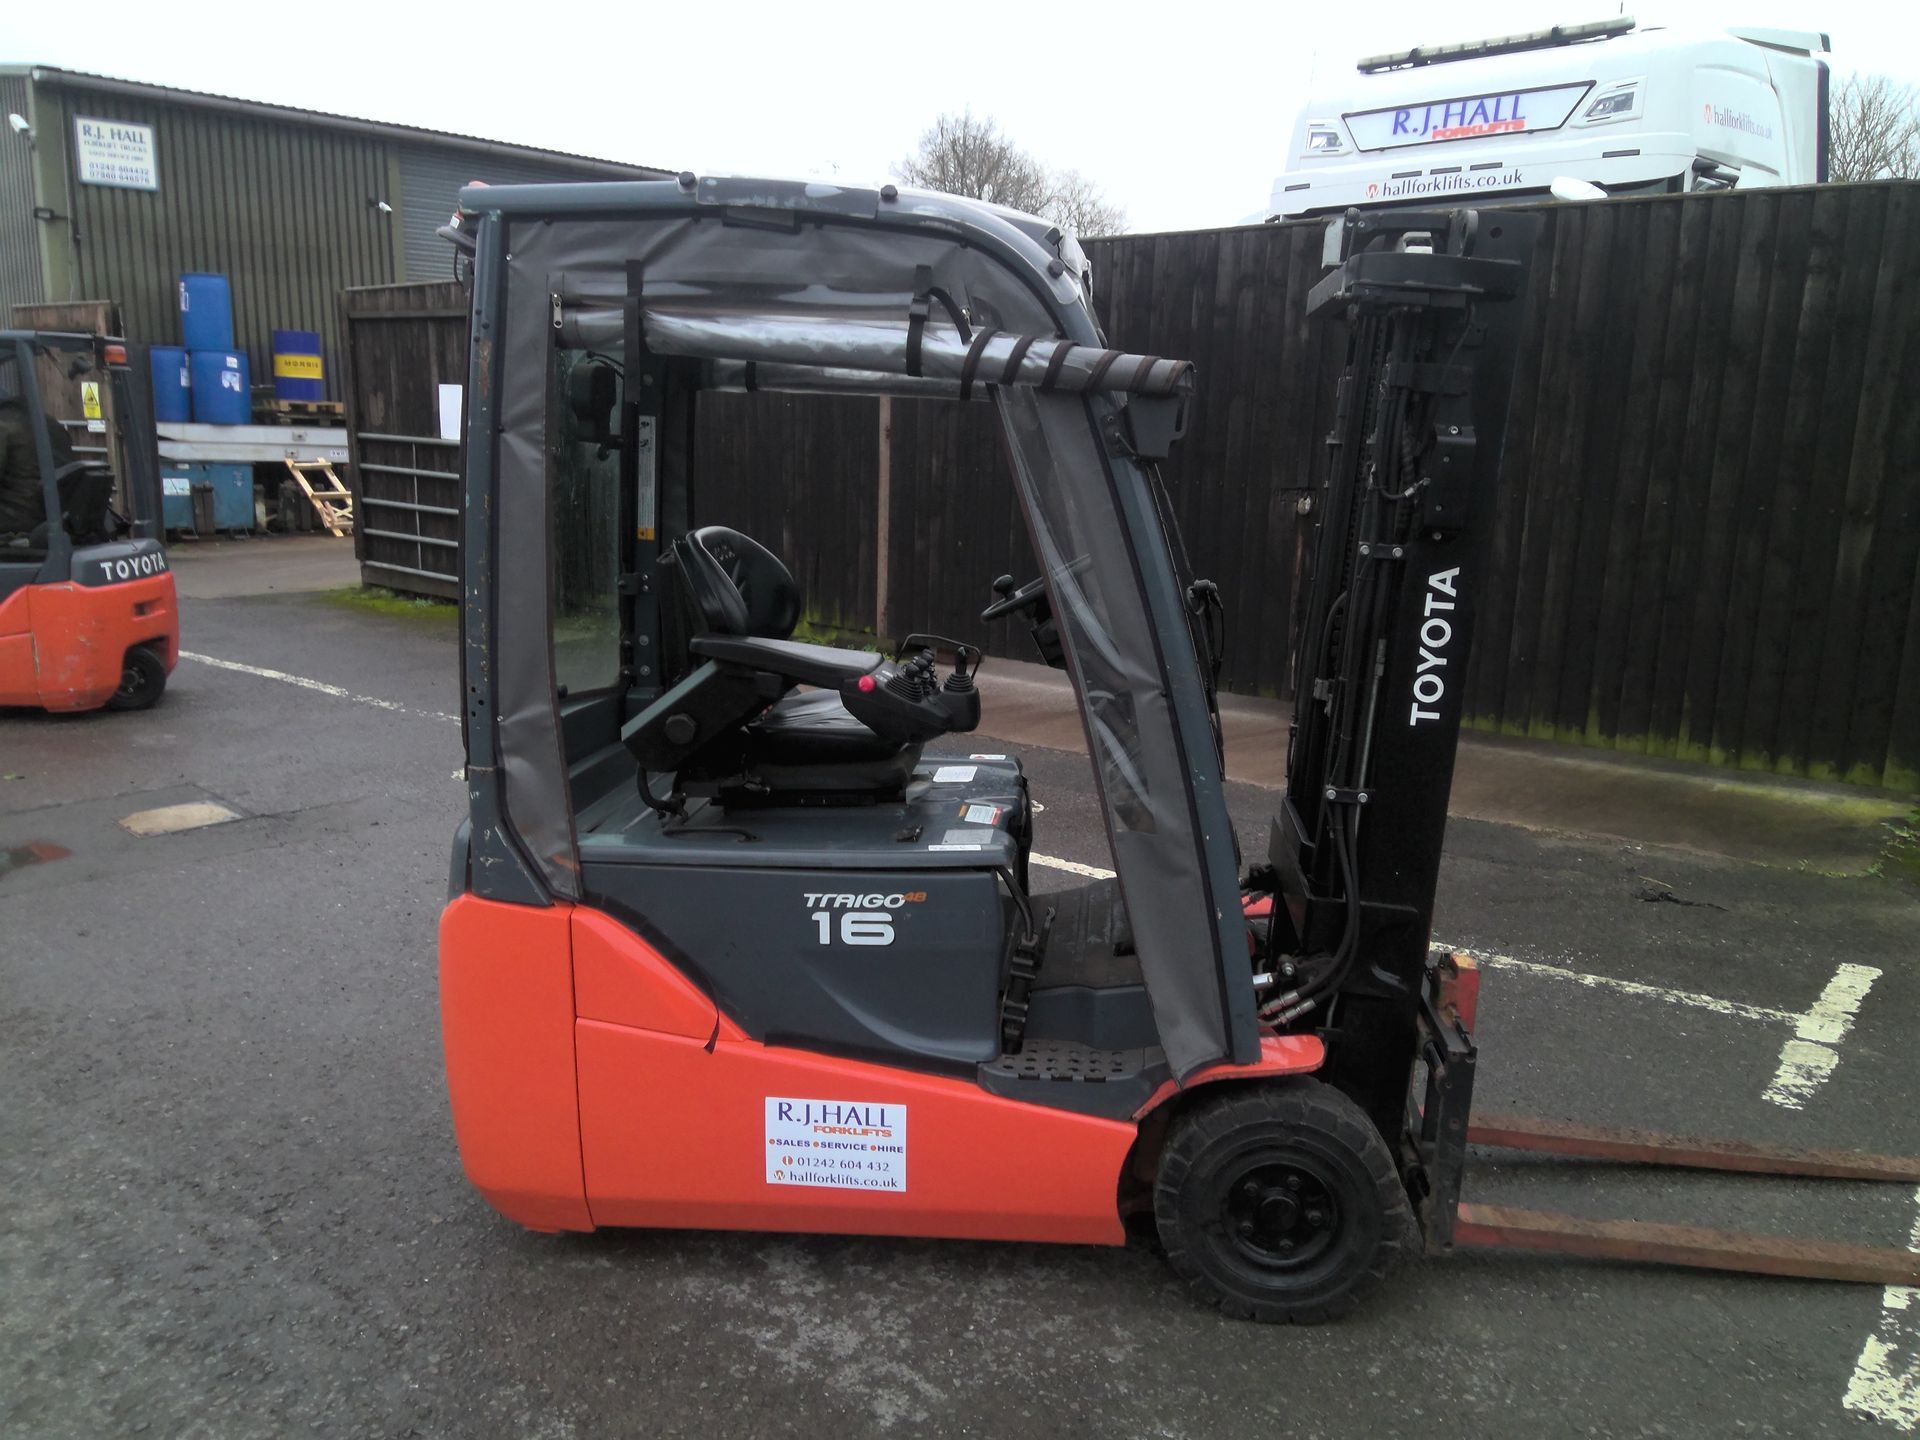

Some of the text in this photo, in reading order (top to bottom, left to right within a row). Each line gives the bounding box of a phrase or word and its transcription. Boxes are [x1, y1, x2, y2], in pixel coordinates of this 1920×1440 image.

[1392, 95, 1526, 136] R.J.HALL
[110, 128, 146, 144] HALL
[1432, 119, 1526, 139] FORKLIFTS
[1382, 169, 1523, 197] hallforklifts.co.uk
[100, 551, 166, 581] TOYOTA
[1409, 566, 1460, 727] TOYOTA
[811, 911, 896, 946] 16
[778, 1102, 893, 1128] R.J.HALL
[813, 1125, 893, 1138] FORKLIFTS
[776, 1138, 904, 1154] SALES SERVICE HIRE
[797, 1157, 889, 1172] 01242 604 432
[789, 1170, 898, 1188] hallforklifts.co.uk
